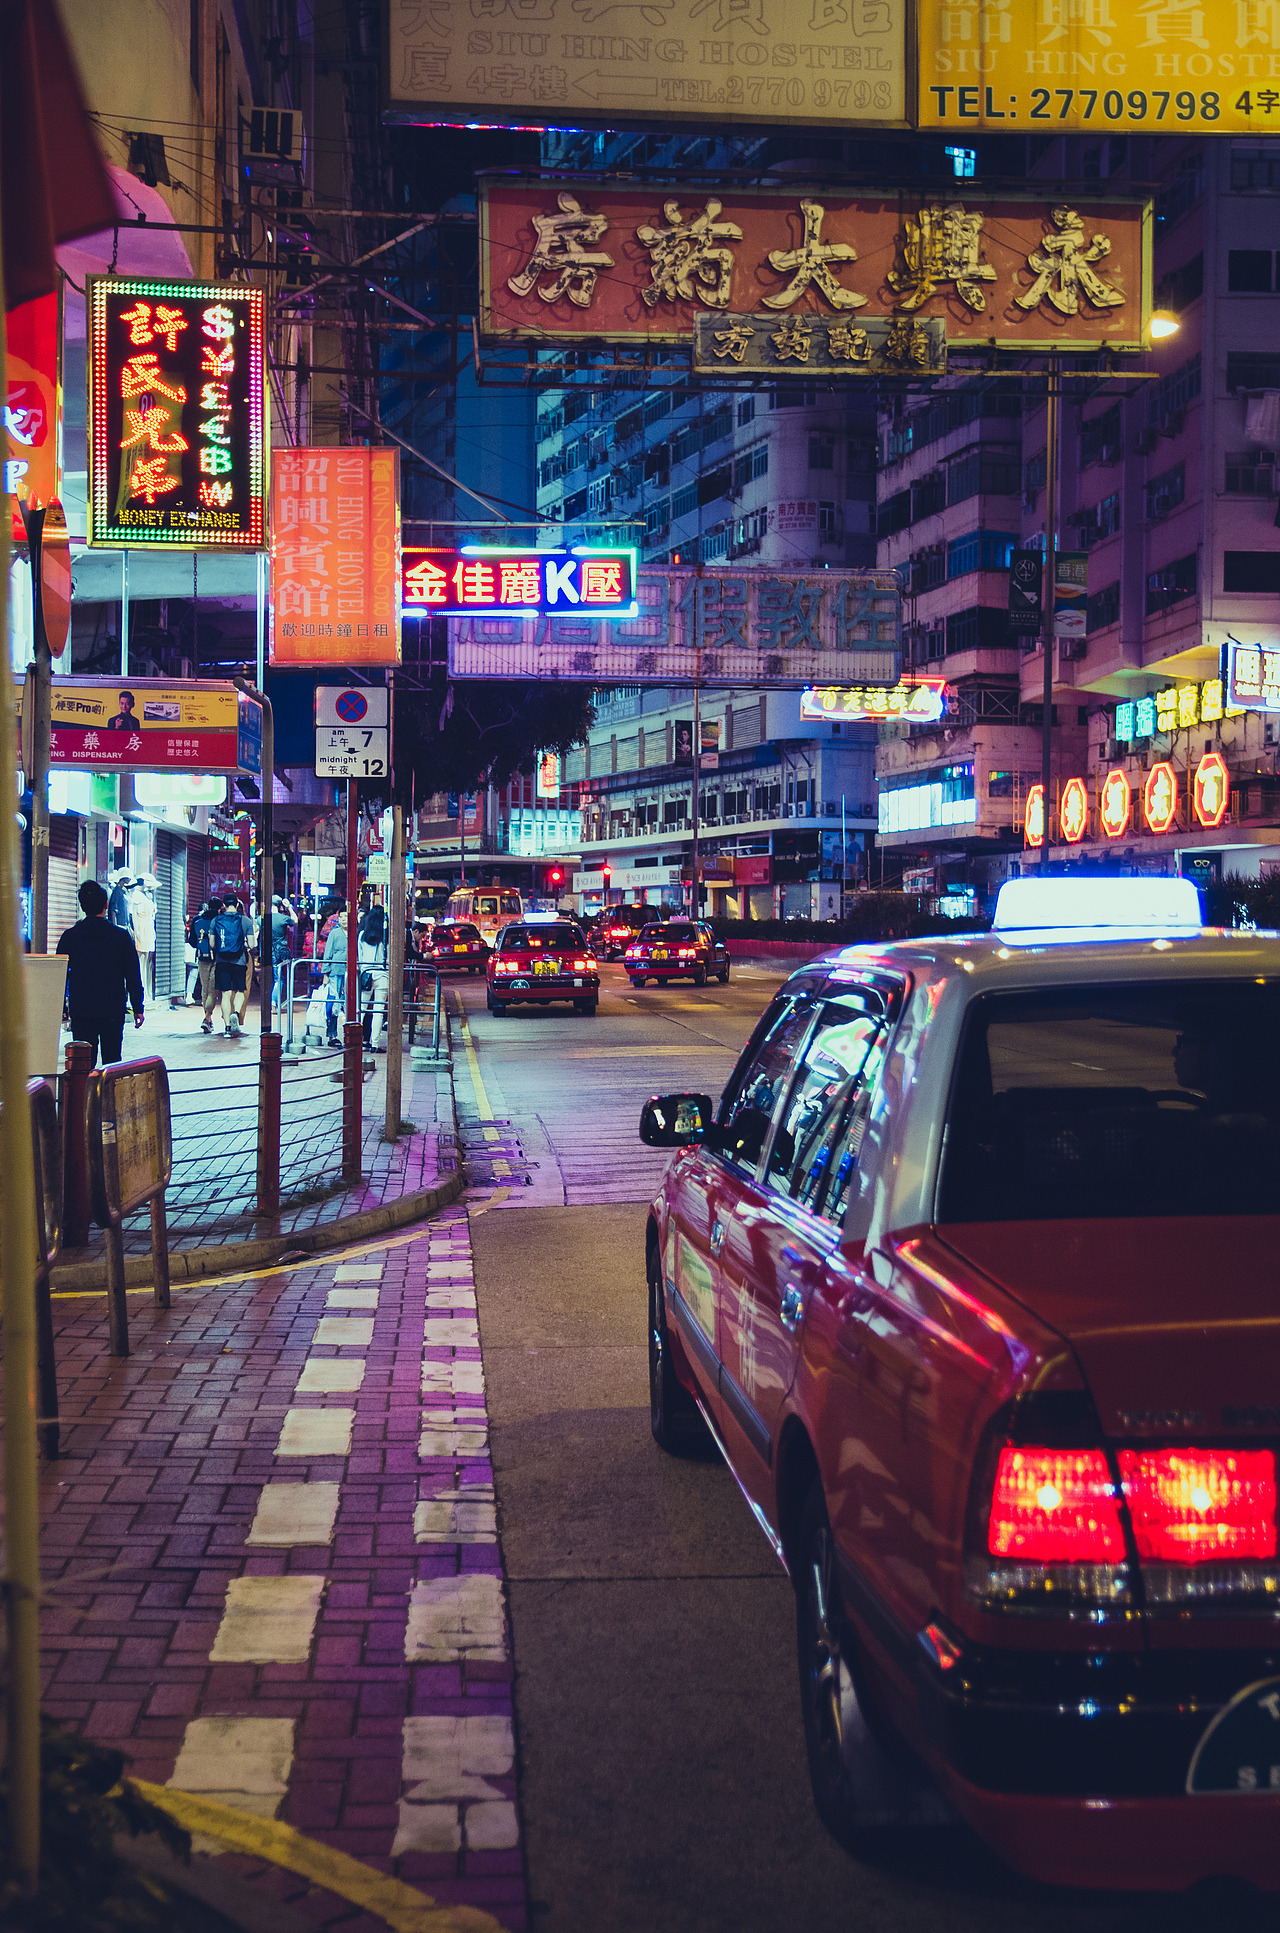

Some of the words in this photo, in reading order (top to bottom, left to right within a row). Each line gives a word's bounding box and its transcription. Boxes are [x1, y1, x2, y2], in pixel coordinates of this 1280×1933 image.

[467, 30, 551, 57] SIU
[561, 34, 688, 62] HING
[699, 41, 893, 71] HOSTEL
[935, 49, 999, 73] SIU
[1024, 51, 1128, 76] HING
[466, 63, 568, 100] 4字樓
[813, 78, 891, 109] 9798
[929, 86, 1018, 118] TEL:
[1029, 88, 1221, 121] 27709798
[337, 458, 364, 486] SIU
[118, 509, 164, 525] MONEY
[169, 509, 241, 529] EXCHANGE
[337, 496, 364, 541] HING
[275, 455, 334, 619] 韶興賓館
[372, 484, 391, 618] 27709798
[1058, 563, 1086, 578] 香港
[337, 550, 364, 619] HOSTEL
[281, 622, 389, 638] 歡迎時鐘日租
[328, 738, 349, 747] 上午
[361, 731, 373, 748] 7
[72, 751, 123, 759] DISPENSARY
[319, 756, 357, 764] midnight
[362, 759, 384, 776] 12
[328, 765, 349, 775] 午夜
